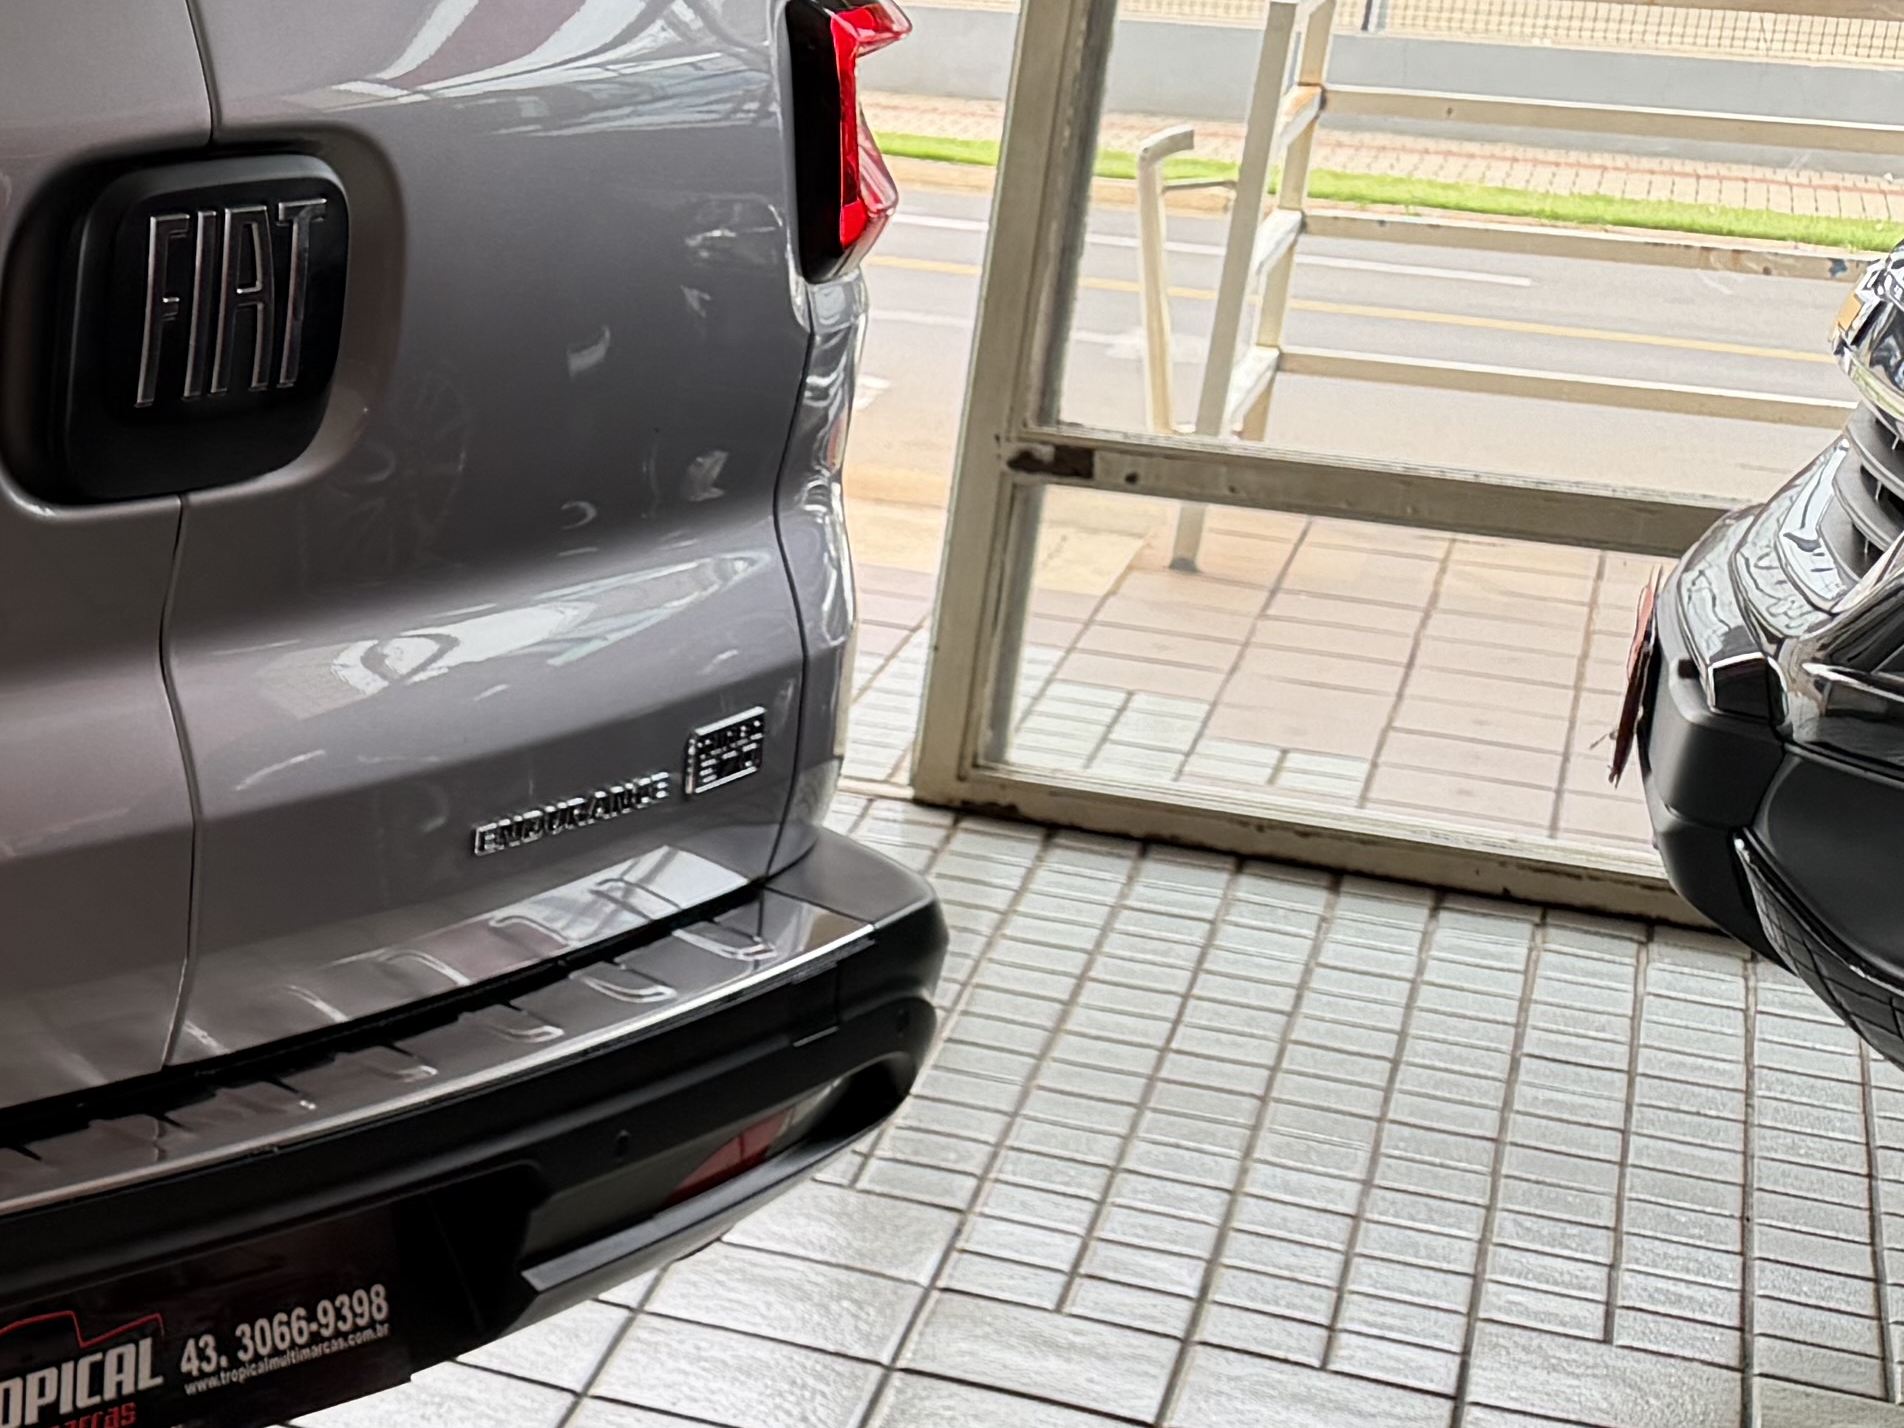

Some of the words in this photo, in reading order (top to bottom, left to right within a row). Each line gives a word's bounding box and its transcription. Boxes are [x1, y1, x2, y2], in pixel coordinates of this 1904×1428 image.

[135, 197, 327, 408] FIAT
[473, 771, 670, 857] ENDURANCE
[180, 1333, 229, 1377] 43.
[235, 1283, 389, 1362] 3066-9398
[184, 1323, 391, 1396] www.tropicalmultimarcas.com.br
